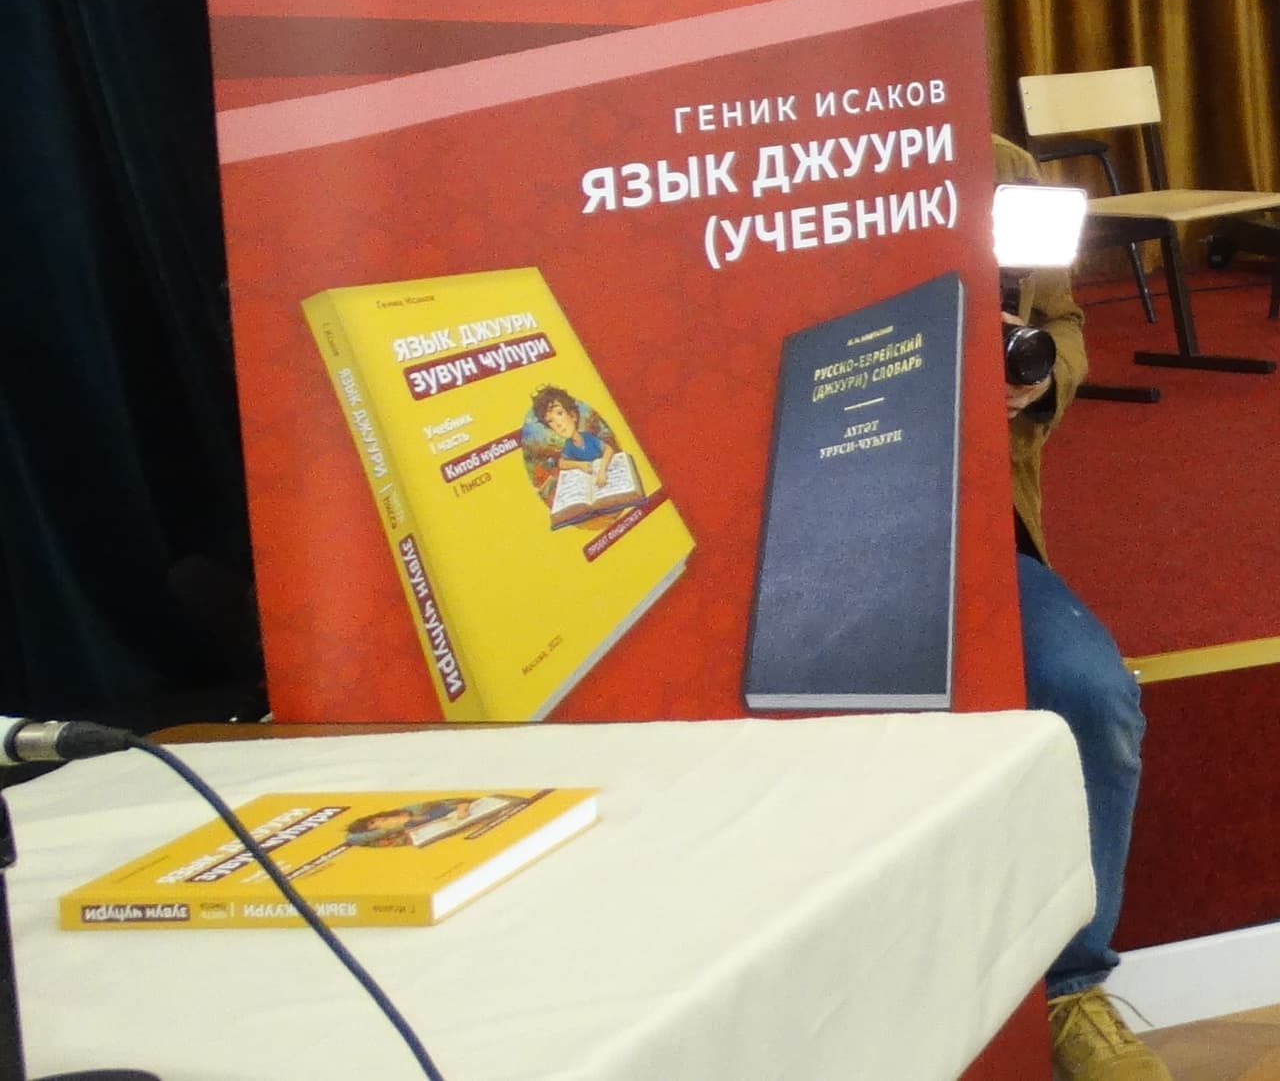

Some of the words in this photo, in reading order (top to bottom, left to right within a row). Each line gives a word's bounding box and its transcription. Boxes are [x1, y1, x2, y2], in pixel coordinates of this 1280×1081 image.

[675, 95, 797, 133] ГЕНИК
[816, 80, 946, 117] ИСАКОВ
[581, 150, 737, 214] ЯЗЫК
[752, 123, 953, 197] ДЖУУРИ
[705, 180, 958, 269] (УЧЕБНИК)
[392, 329, 456, 362] ЯЗЫК
[460, 311, 538, 346] ДЖУУРИ
[409, 355, 480, 394] зувун
[872, 354, 923, 382] СЛОВАРЬ
[402, 538, 429, 597] зувун
